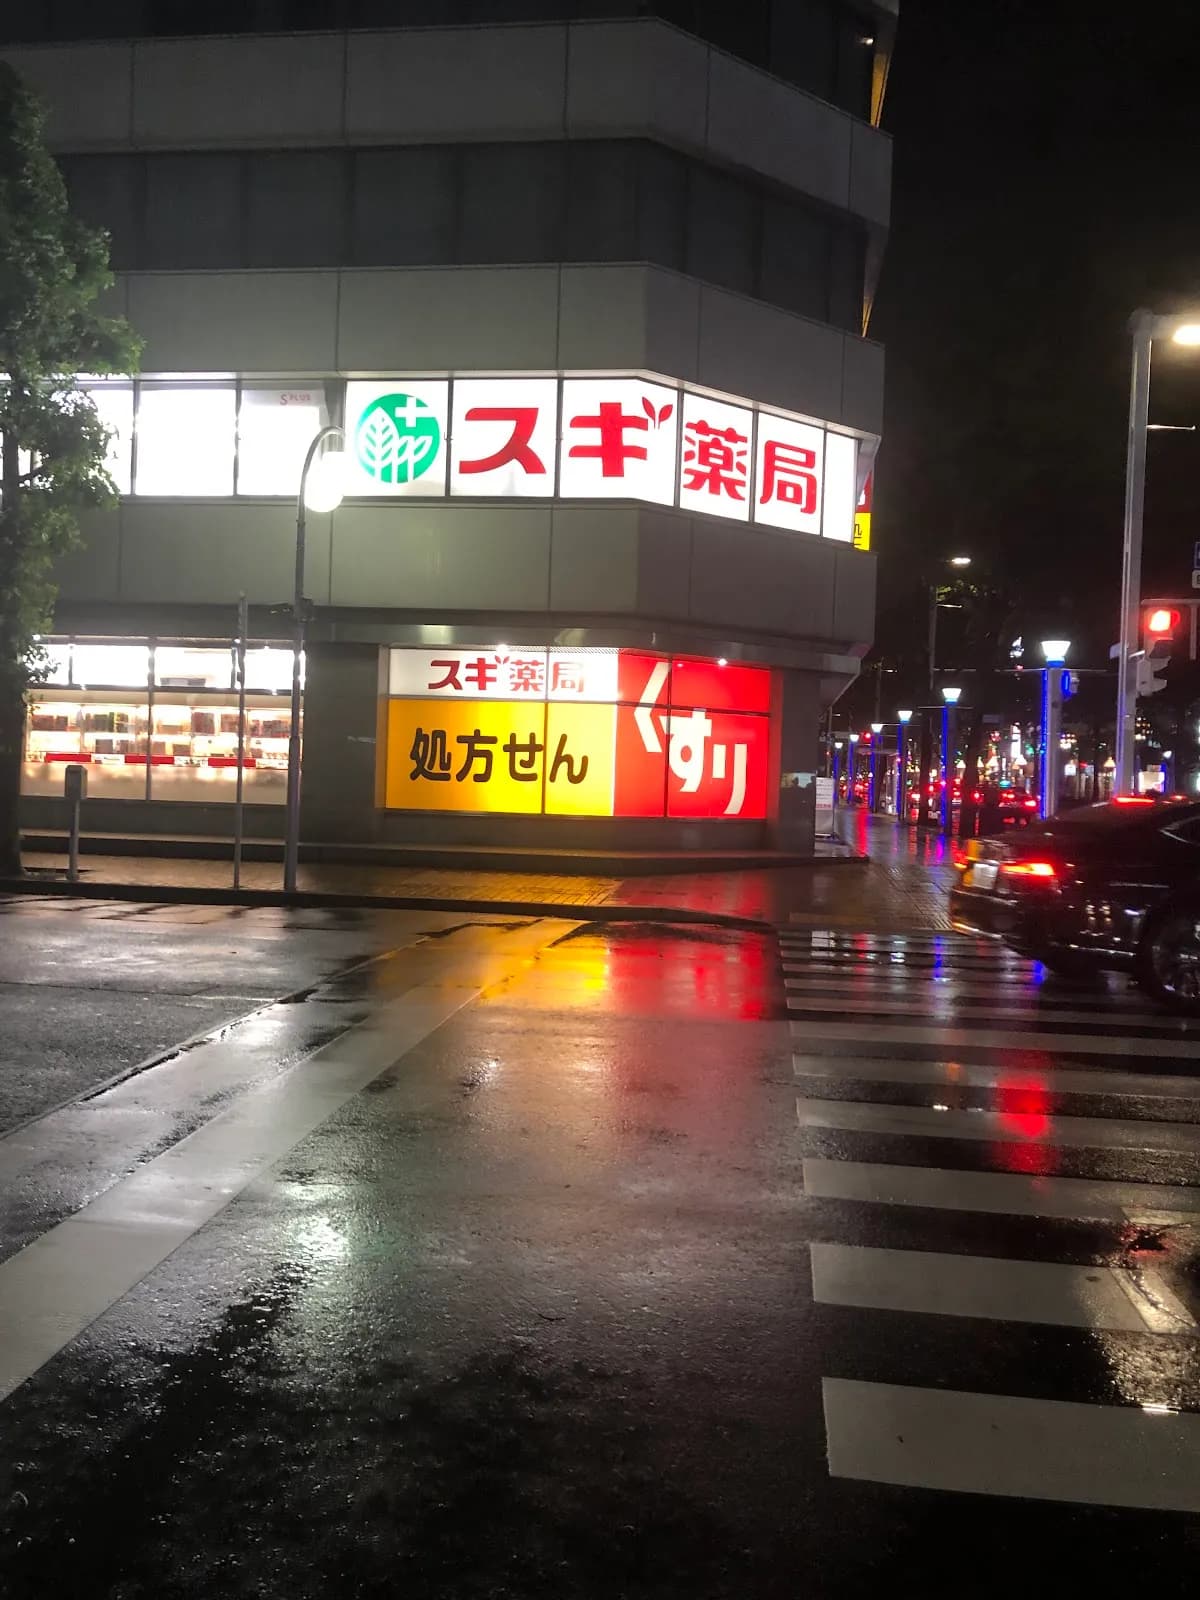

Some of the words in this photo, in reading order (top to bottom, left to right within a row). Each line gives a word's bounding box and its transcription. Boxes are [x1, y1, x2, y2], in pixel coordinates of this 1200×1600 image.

[458, 396, 818, 515] スギ薬局
[428, 655, 586, 693] スギ薬局
[410, 727, 589, 785] 処方せん
[633, 661, 748, 815] くすり
